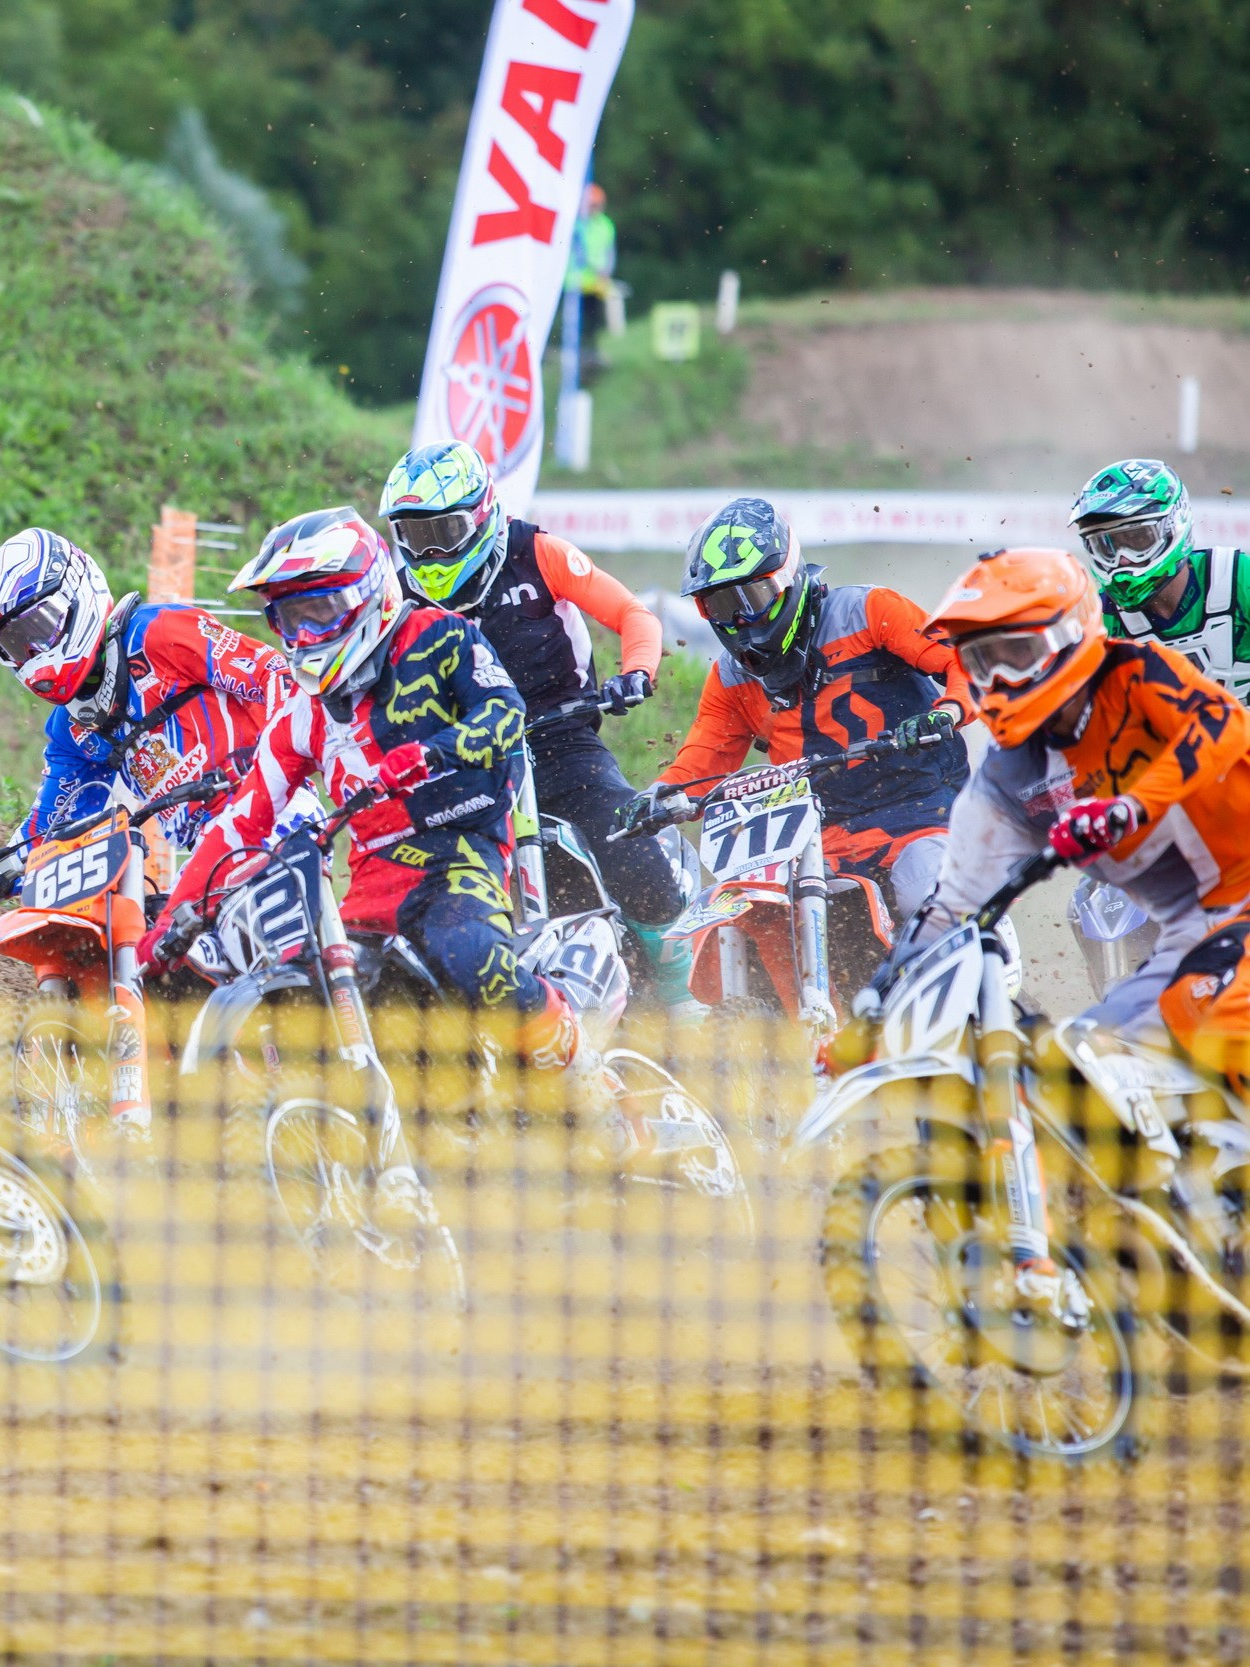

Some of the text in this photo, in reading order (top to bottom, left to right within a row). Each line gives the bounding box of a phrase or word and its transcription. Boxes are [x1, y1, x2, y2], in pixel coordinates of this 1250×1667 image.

[98, 667, 117, 712] 655
[210, 669, 265, 703] NIAG
[425, 793, 496, 829] NIAGARA
[391, 843, 435, 868] FOX
[709, 803, 809, 874] 717
[35, 839, 109, 909] 655
